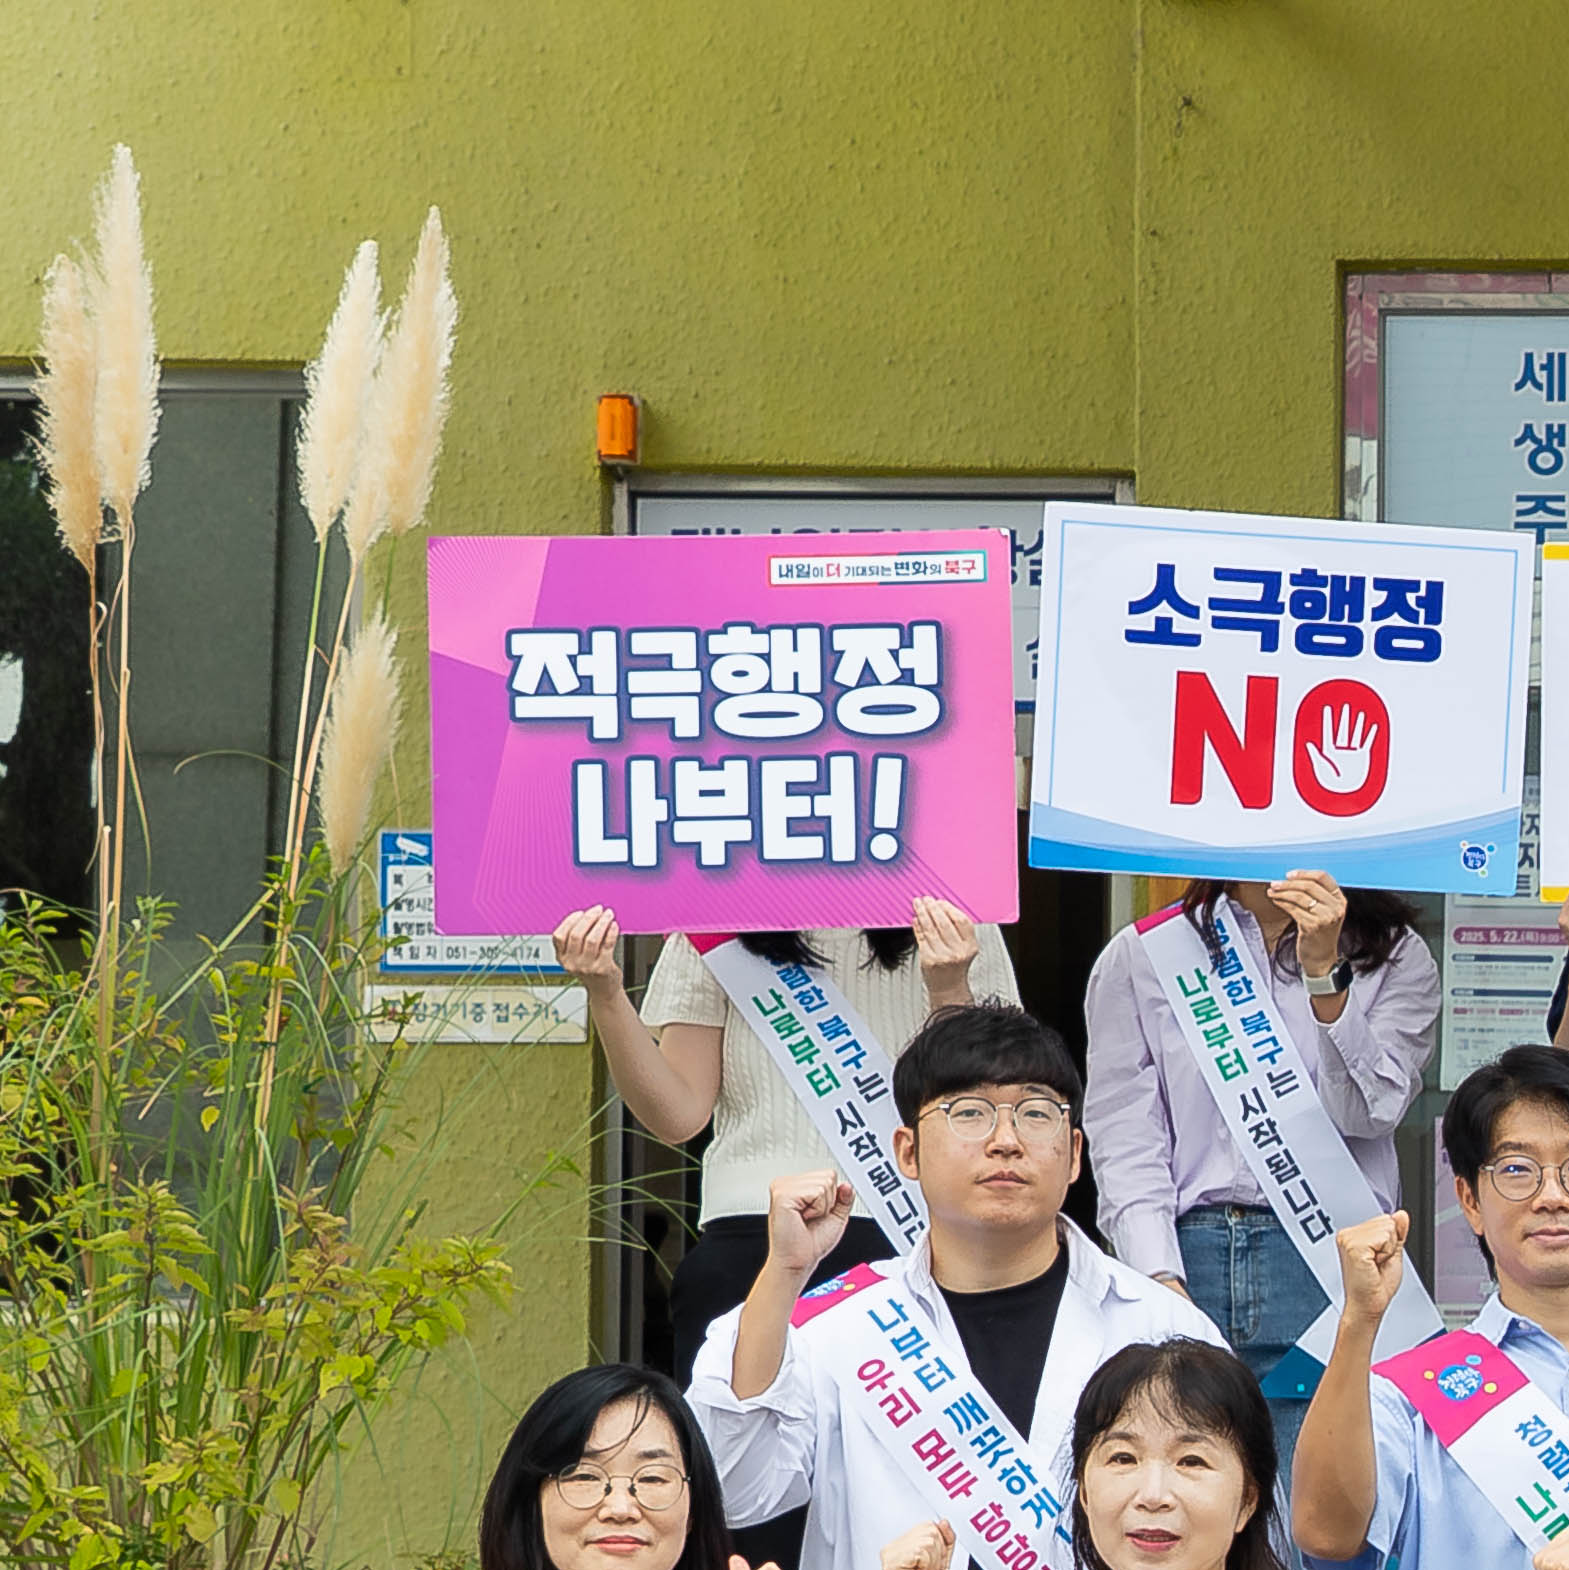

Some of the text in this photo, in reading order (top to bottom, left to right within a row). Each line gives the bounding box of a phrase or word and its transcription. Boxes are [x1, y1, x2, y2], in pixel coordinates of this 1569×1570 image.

[1125, 564, 1444, 662] 소극행정
[512, 626, 939, 738] 적극행정
[1171, 670, 1389, 817] NO
[576, 755, 904, 866] 나부터!
[751, 988, 841, 1098] 나로부터
[816, 1014, 889, 1104] 북구는
[1239, 1011, 1300, 1100] 북구는
[1175, 970, 1334, 1244] 나로부터 시작됩니다
[867, 1298, 956, 1393] 나부터
[856, 1358, 923, 1428] 우리
[911, 1428, 984, 1500] 모두
